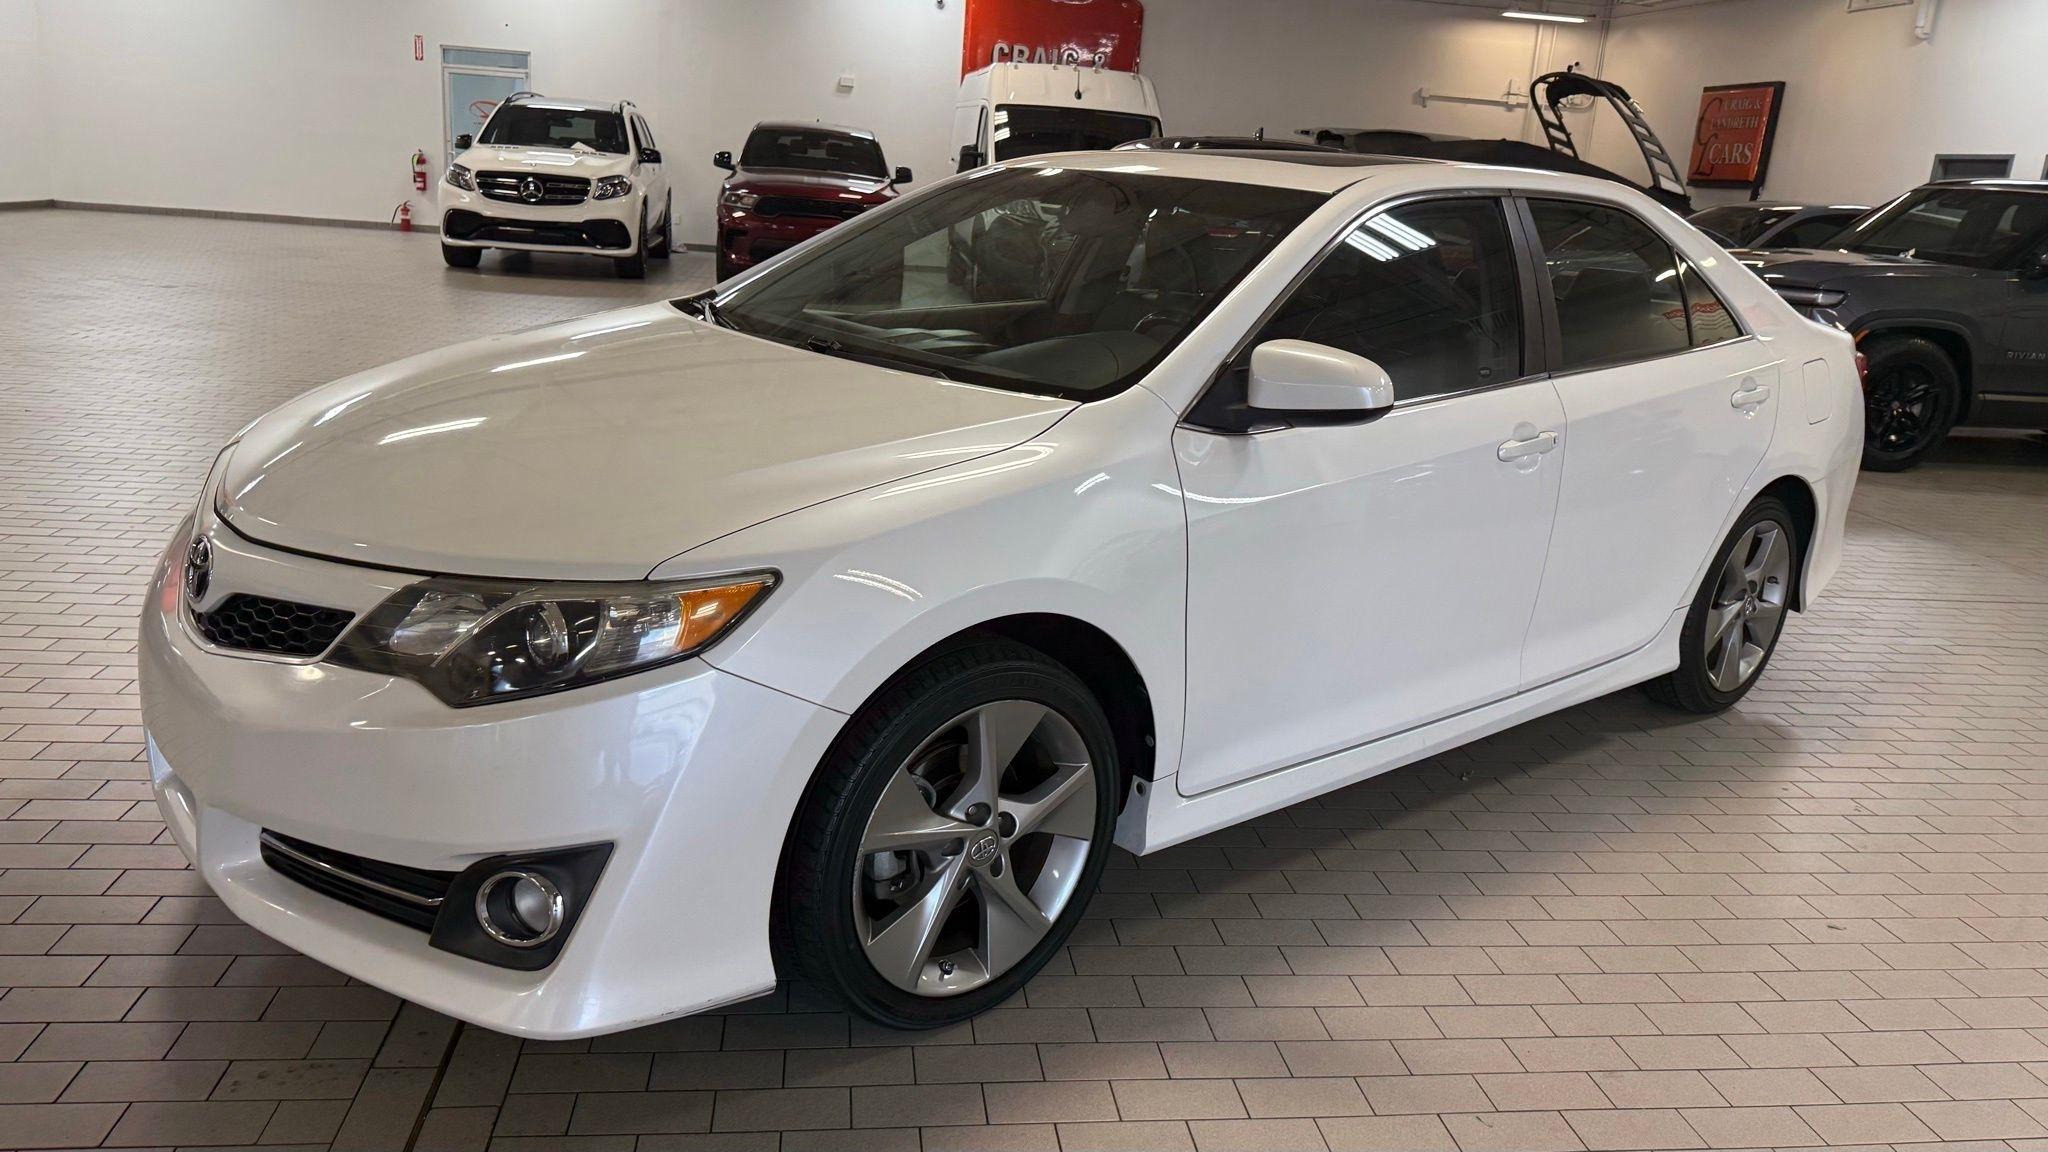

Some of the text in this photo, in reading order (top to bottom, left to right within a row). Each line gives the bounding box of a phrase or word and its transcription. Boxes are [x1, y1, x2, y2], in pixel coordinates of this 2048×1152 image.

[992, 42, 1080, 66] CRAIG
[1709, 142, 1754, 165] CARS
[2006, 351, 2046, 360] RIVIAN
